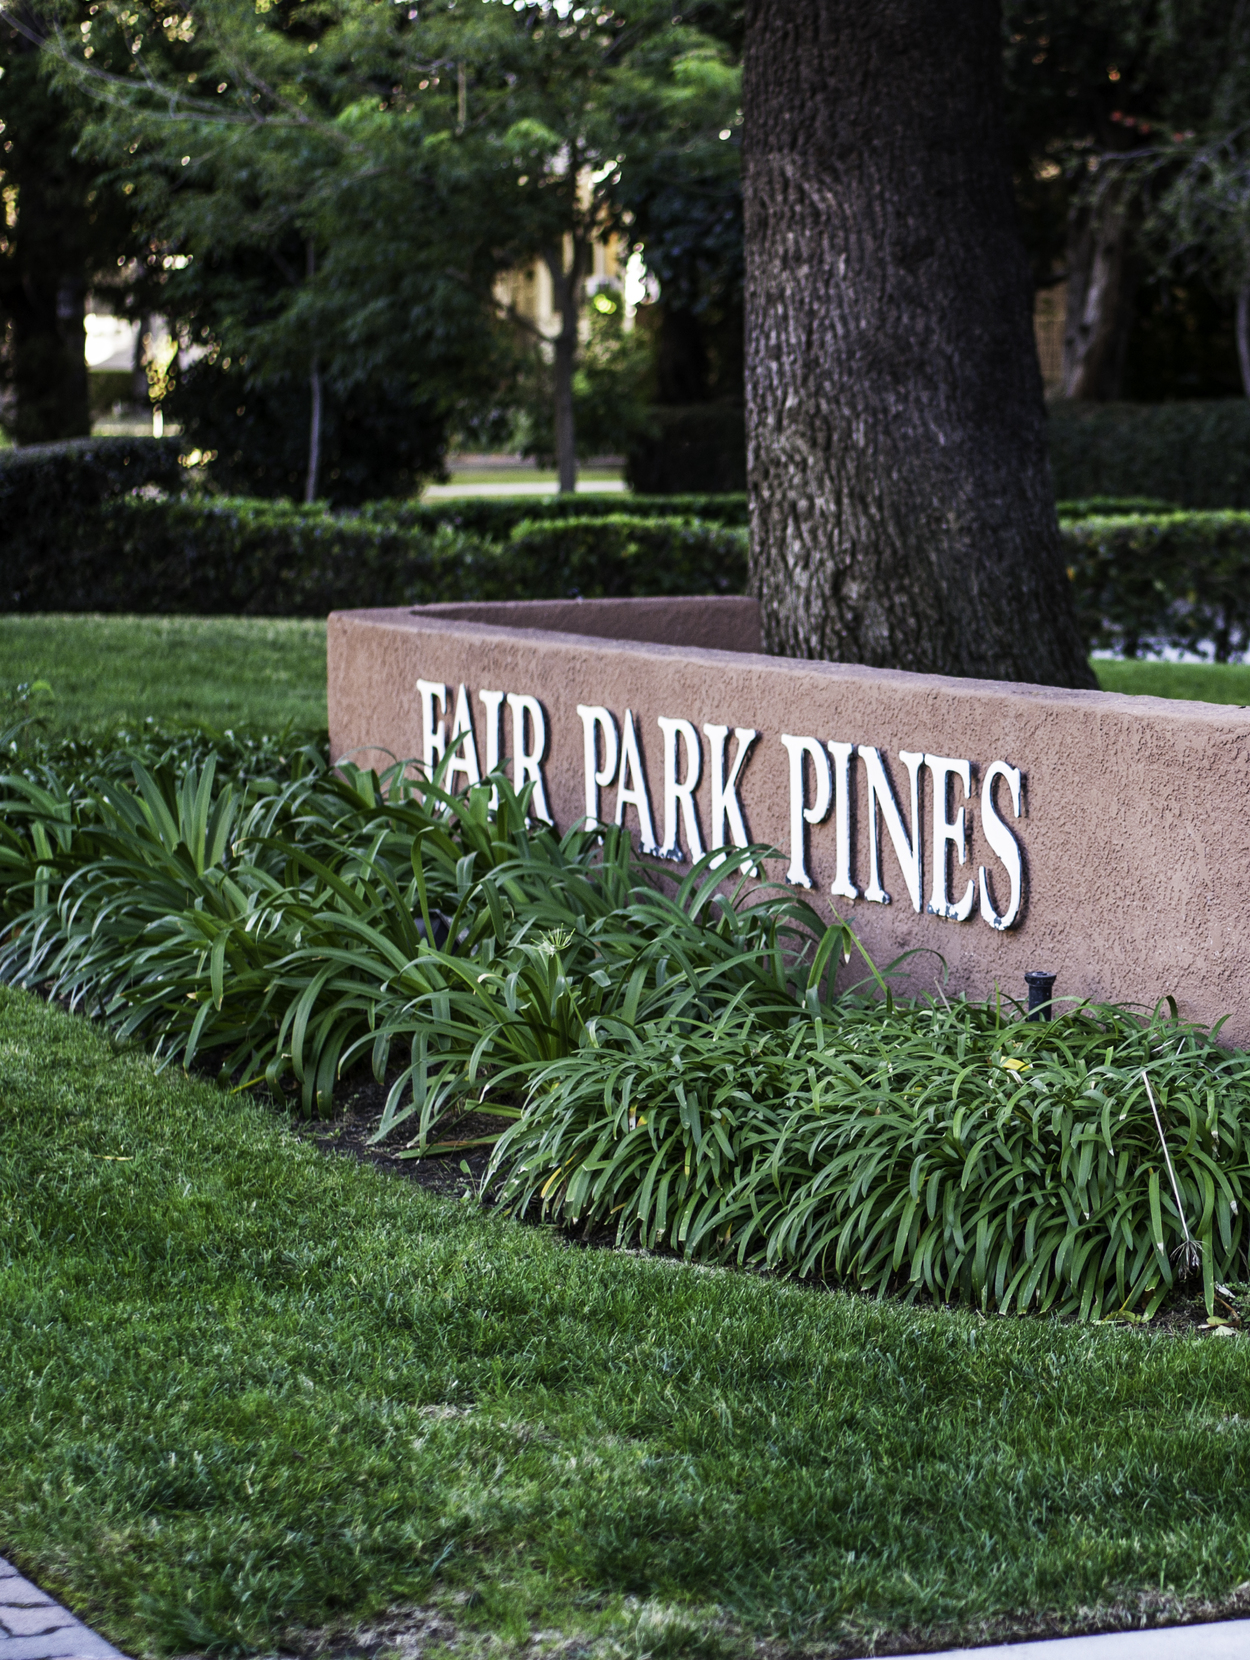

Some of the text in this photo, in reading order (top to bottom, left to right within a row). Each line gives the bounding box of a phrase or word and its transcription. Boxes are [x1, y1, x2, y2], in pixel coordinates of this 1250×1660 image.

[416, 678, 1023, 931] FAIR PARK PINES
